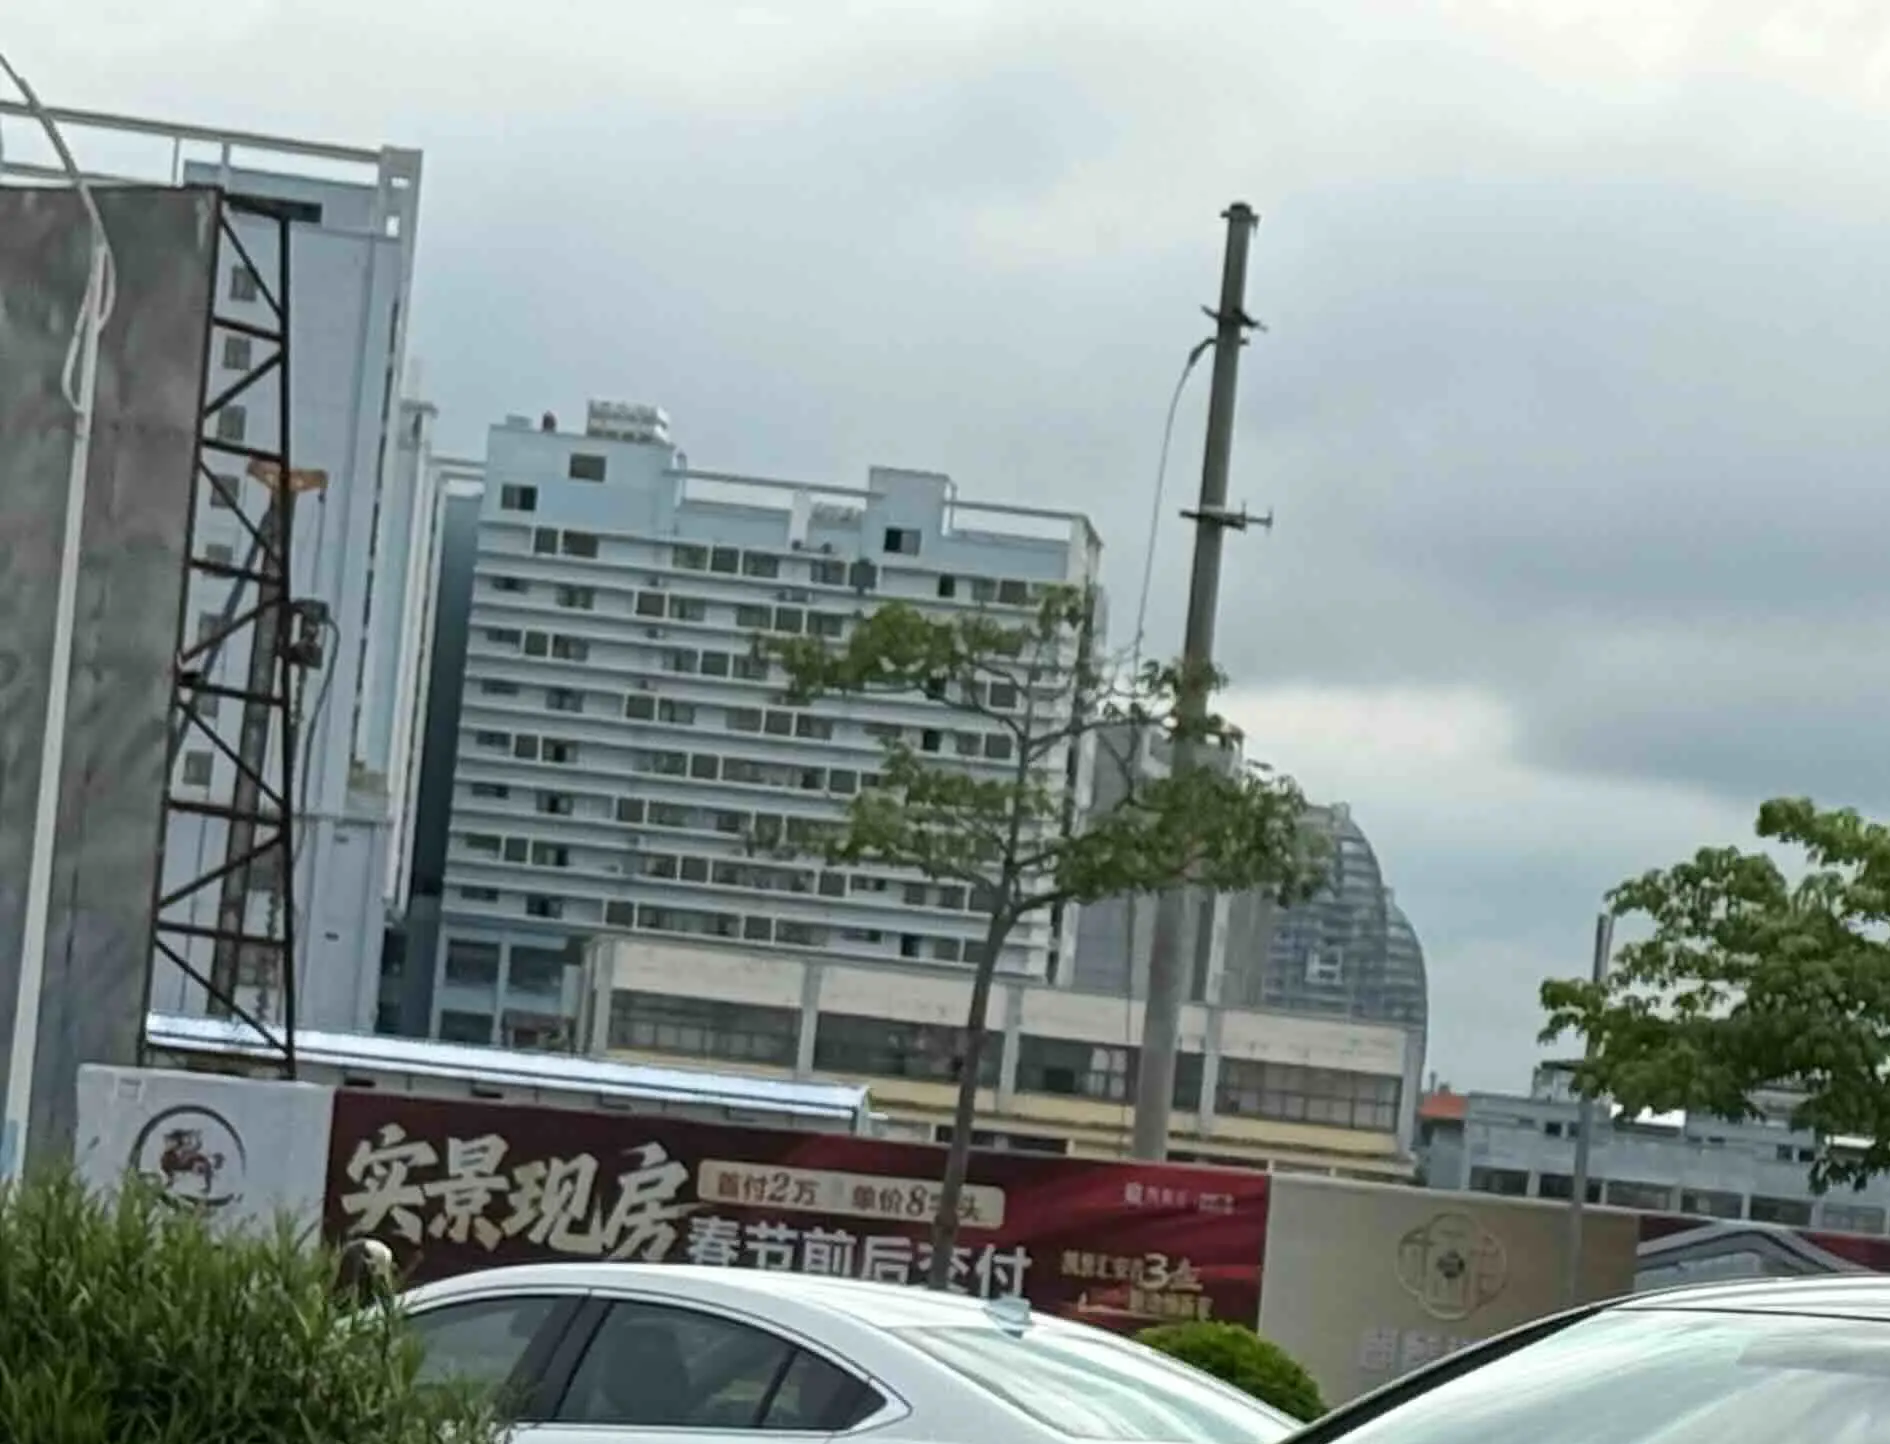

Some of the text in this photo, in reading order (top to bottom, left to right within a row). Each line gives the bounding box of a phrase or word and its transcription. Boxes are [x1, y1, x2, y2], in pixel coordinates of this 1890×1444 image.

[341, 1123, 704, 1264] 实景现房
[717, 1170, 820, 1207] 首付2万
[687, 1214, 1032, 1301] 春节前后交付
